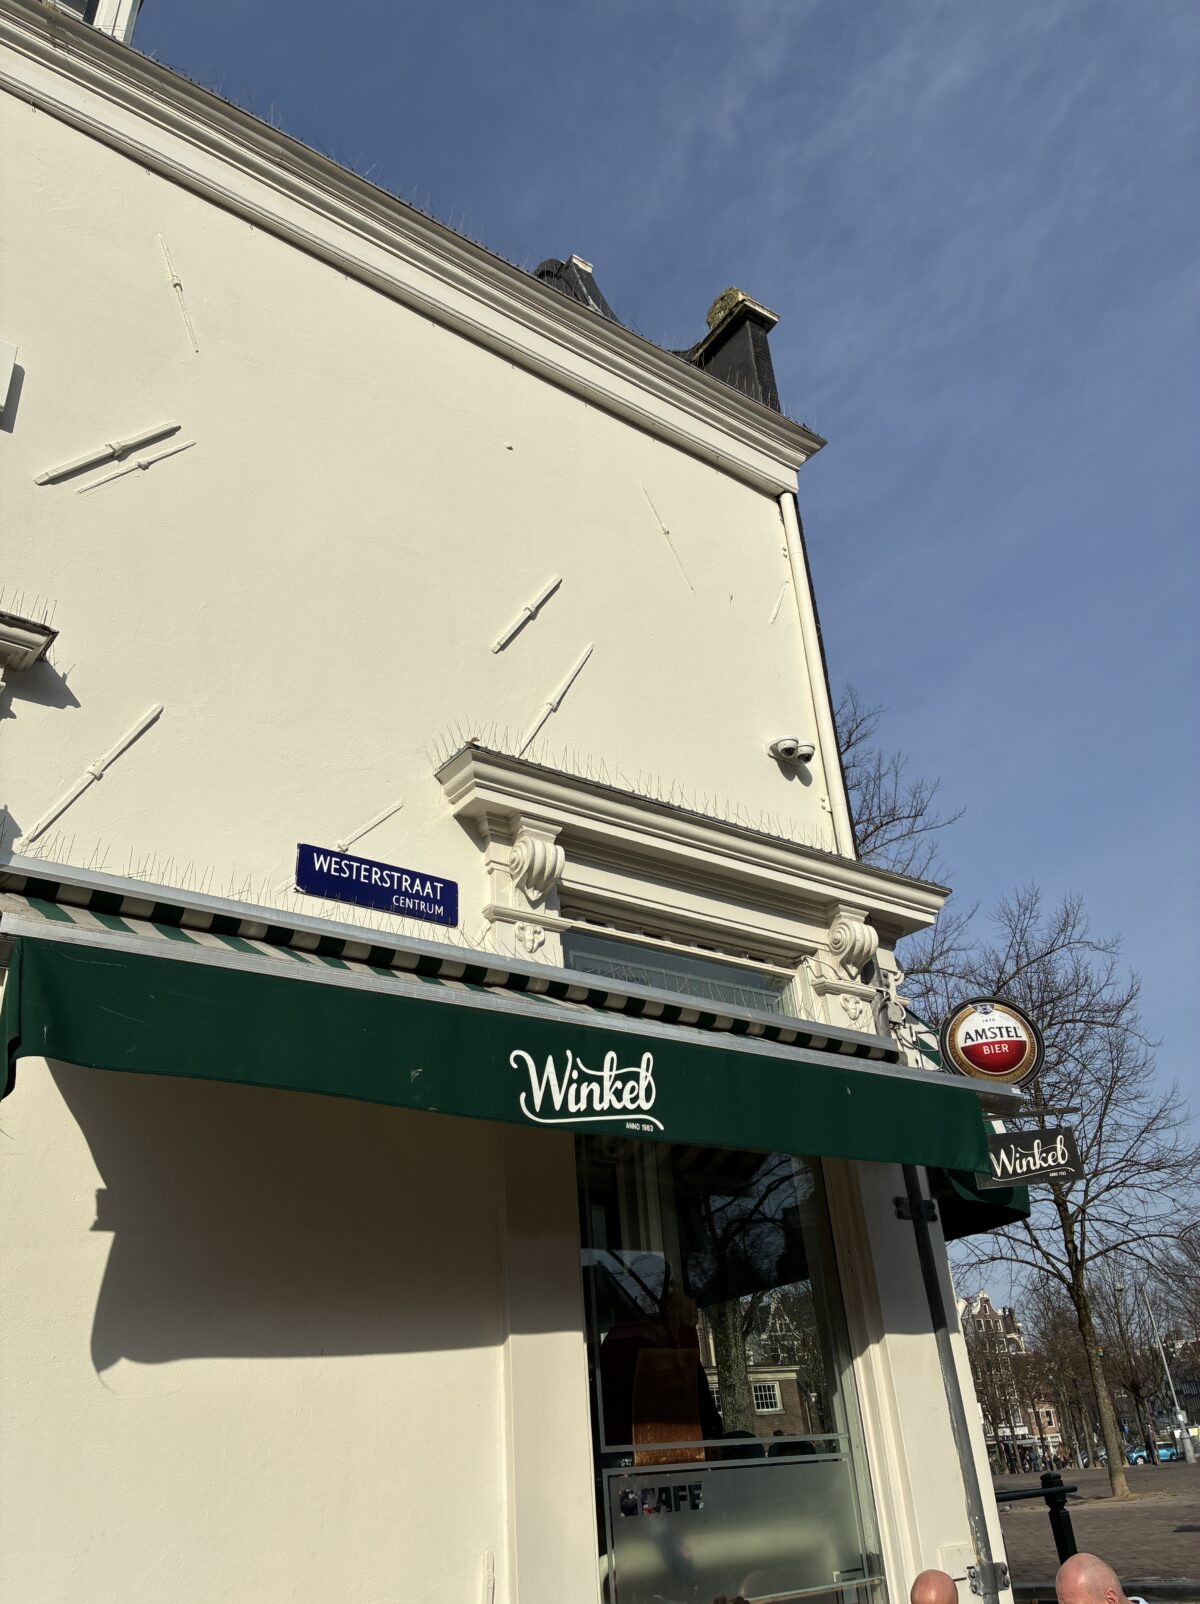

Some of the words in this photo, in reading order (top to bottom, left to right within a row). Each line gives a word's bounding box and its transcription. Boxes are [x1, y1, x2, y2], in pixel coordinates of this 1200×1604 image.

[313, 852, 444, 900] WESTERSTRAAT
[392, 894, 444, 917] CENTRUM
[964, 1026, 1022, 1044] AMSTEL
[983, 1043, 1010, 1055] BIER
[509, 1049, 656, 1113] Winkel
[625, 1121, 641, 1131] ANNO
[989, 1134, 1068, 1178] Winkel
